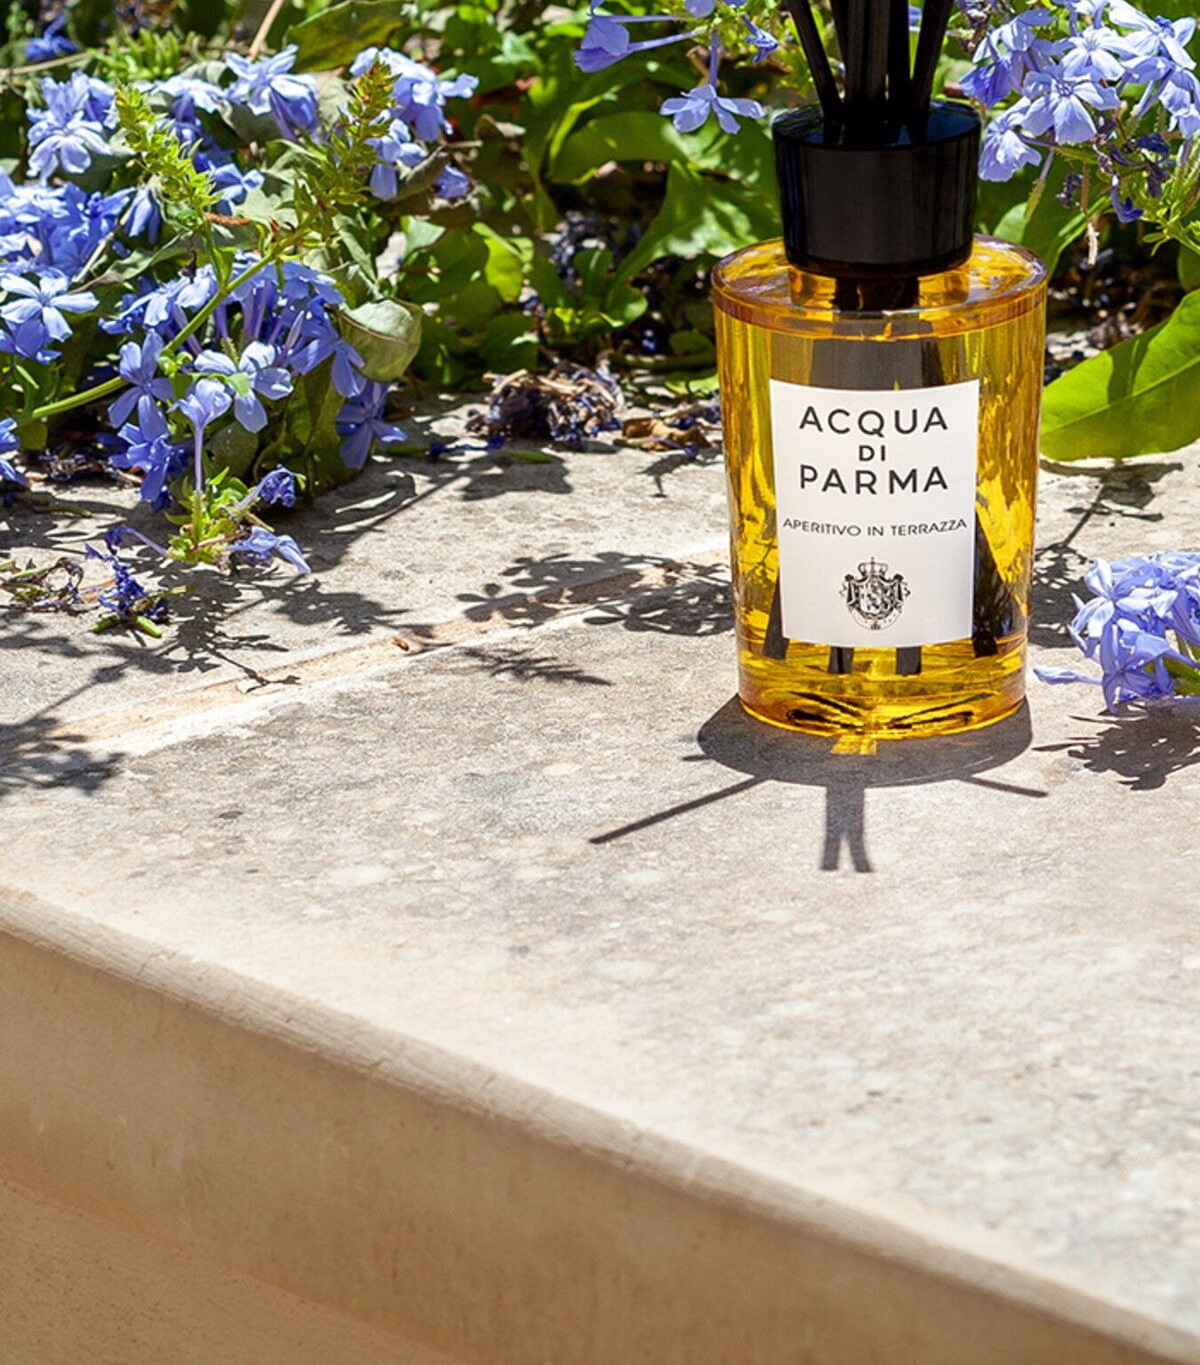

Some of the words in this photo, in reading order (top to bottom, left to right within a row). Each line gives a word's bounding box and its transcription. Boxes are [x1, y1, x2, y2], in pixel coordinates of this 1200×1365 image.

[799, 405, 948, 439] ACQUA
[858, 444, 886, 462] DI
[800, 464, 948, 495] PARMA
[782, 518, 862, 536] APERITIVO
[867, 526, 884, 537] IN
[890, 518, 968, 536] TERRAZZA
